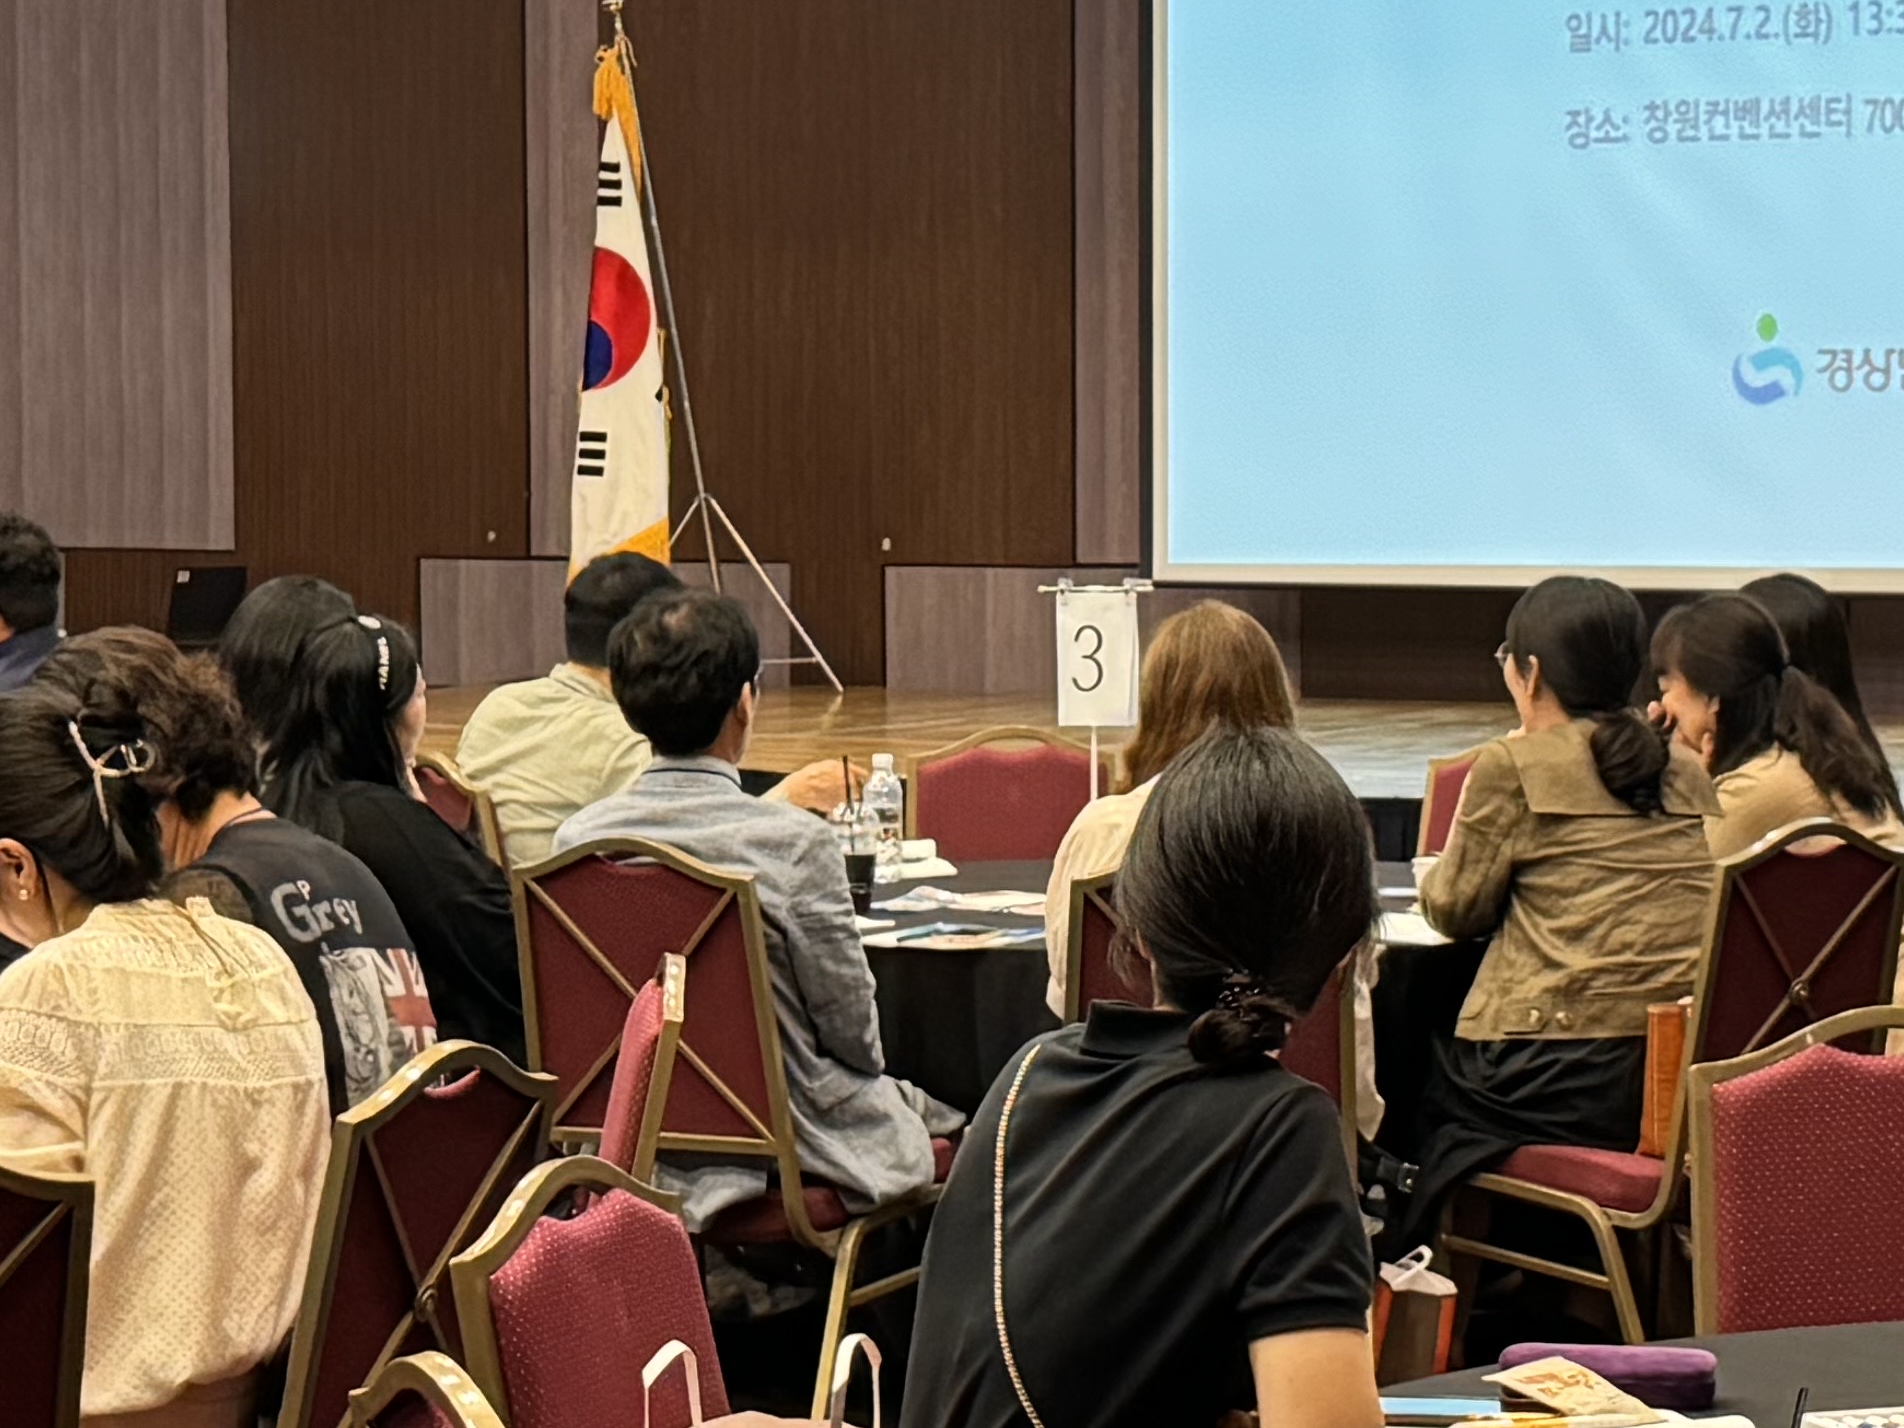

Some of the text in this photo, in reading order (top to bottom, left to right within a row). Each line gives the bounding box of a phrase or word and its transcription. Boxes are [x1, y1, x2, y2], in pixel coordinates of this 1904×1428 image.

[1564, 11, 1631, 53] 일시:
[1642, 2, 1834, 47] 2024.7.2.(화)
[1564, 107, 1631, 150] 장소:
[1642, 92, 1852, 144] 창원컨벤션센터
[1071, 624, 1104, 692] 3
[270, 882, 364, 943] Grey
